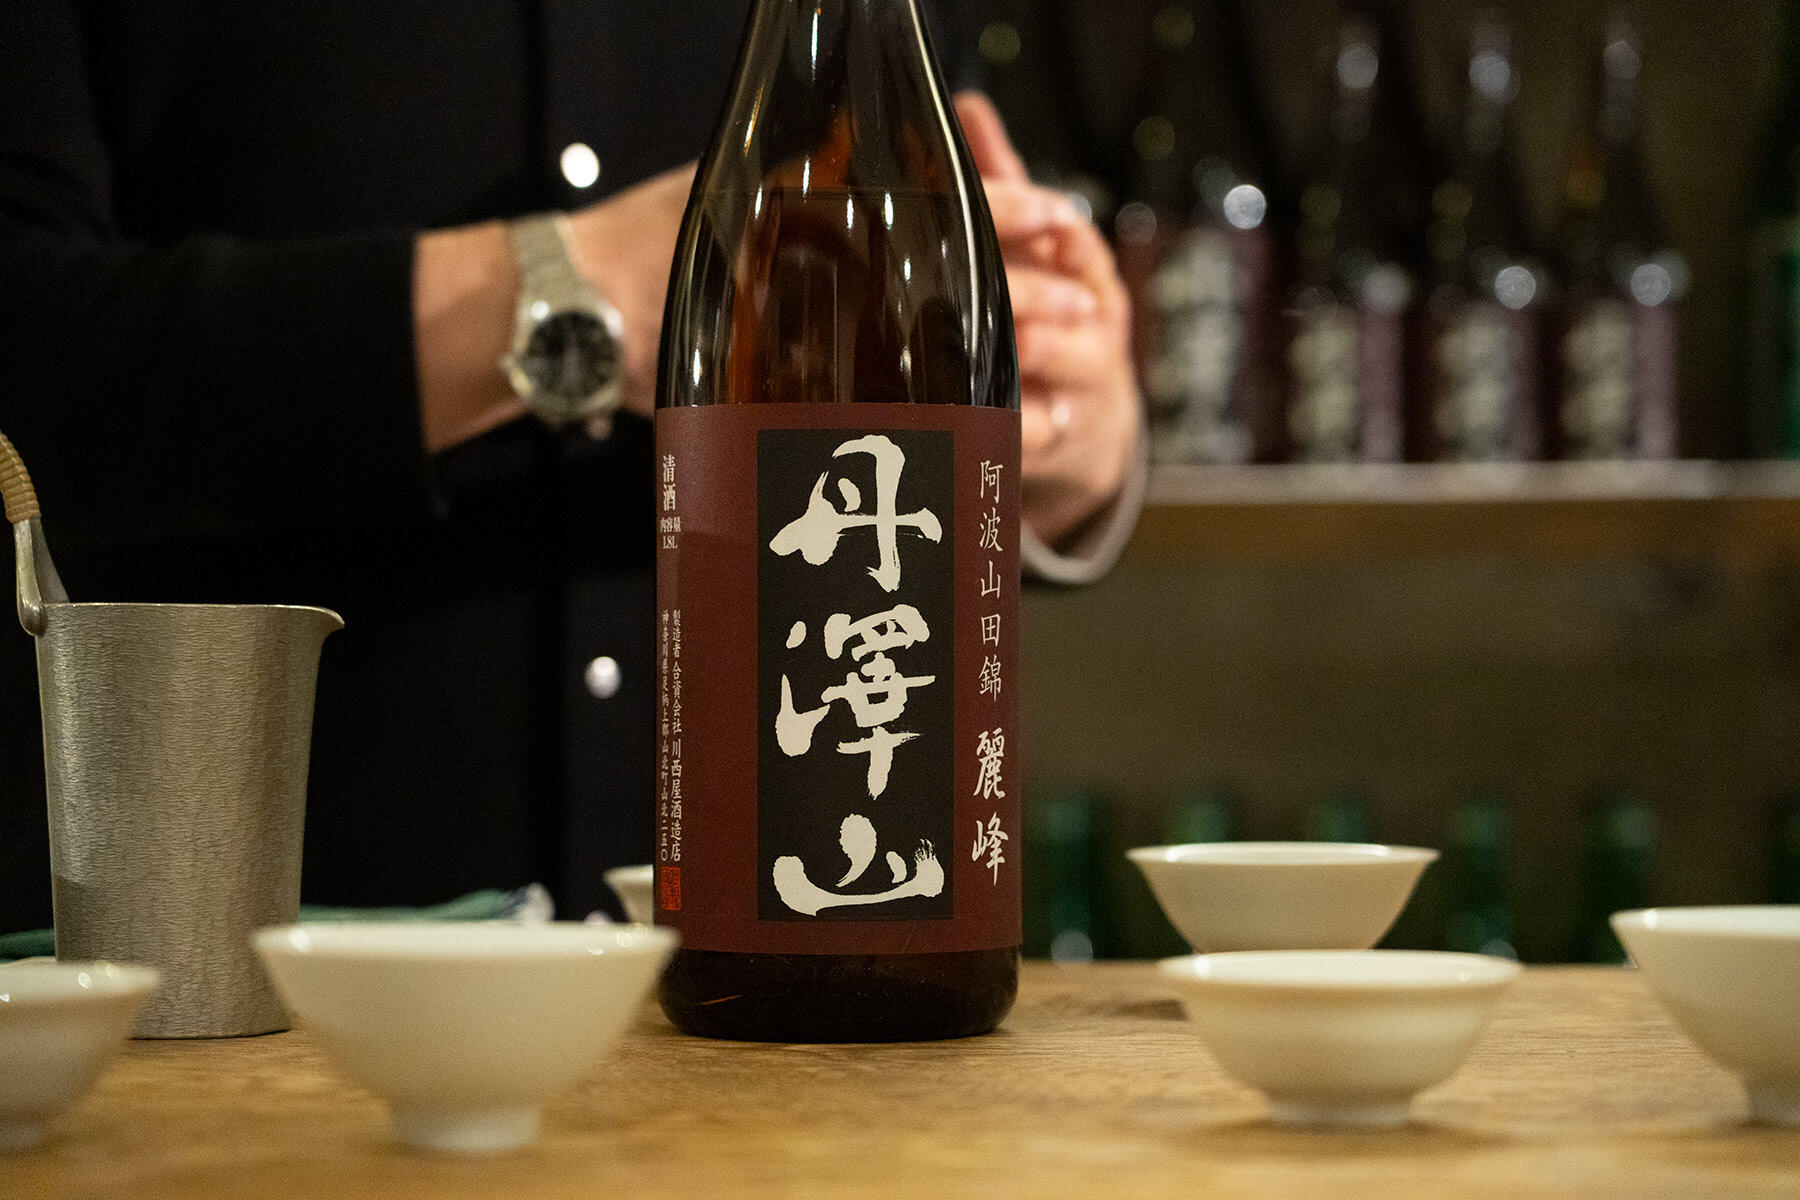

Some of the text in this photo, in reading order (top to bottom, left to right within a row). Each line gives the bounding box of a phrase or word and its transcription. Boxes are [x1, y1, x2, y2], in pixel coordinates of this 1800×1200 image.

[663, 454, 676, 511] 清酒
[660, 516, 681, 533] 内容量
[672, 609, 682, 658] 製造者
[672, 661, 683, 735] 合資会社
[769, 435, 944, 917] 丹澤山
[971, 459, 1009, 887] 阿波山田錦 麗峰
[671, 738, 683, 862] 川西屋酒造店
